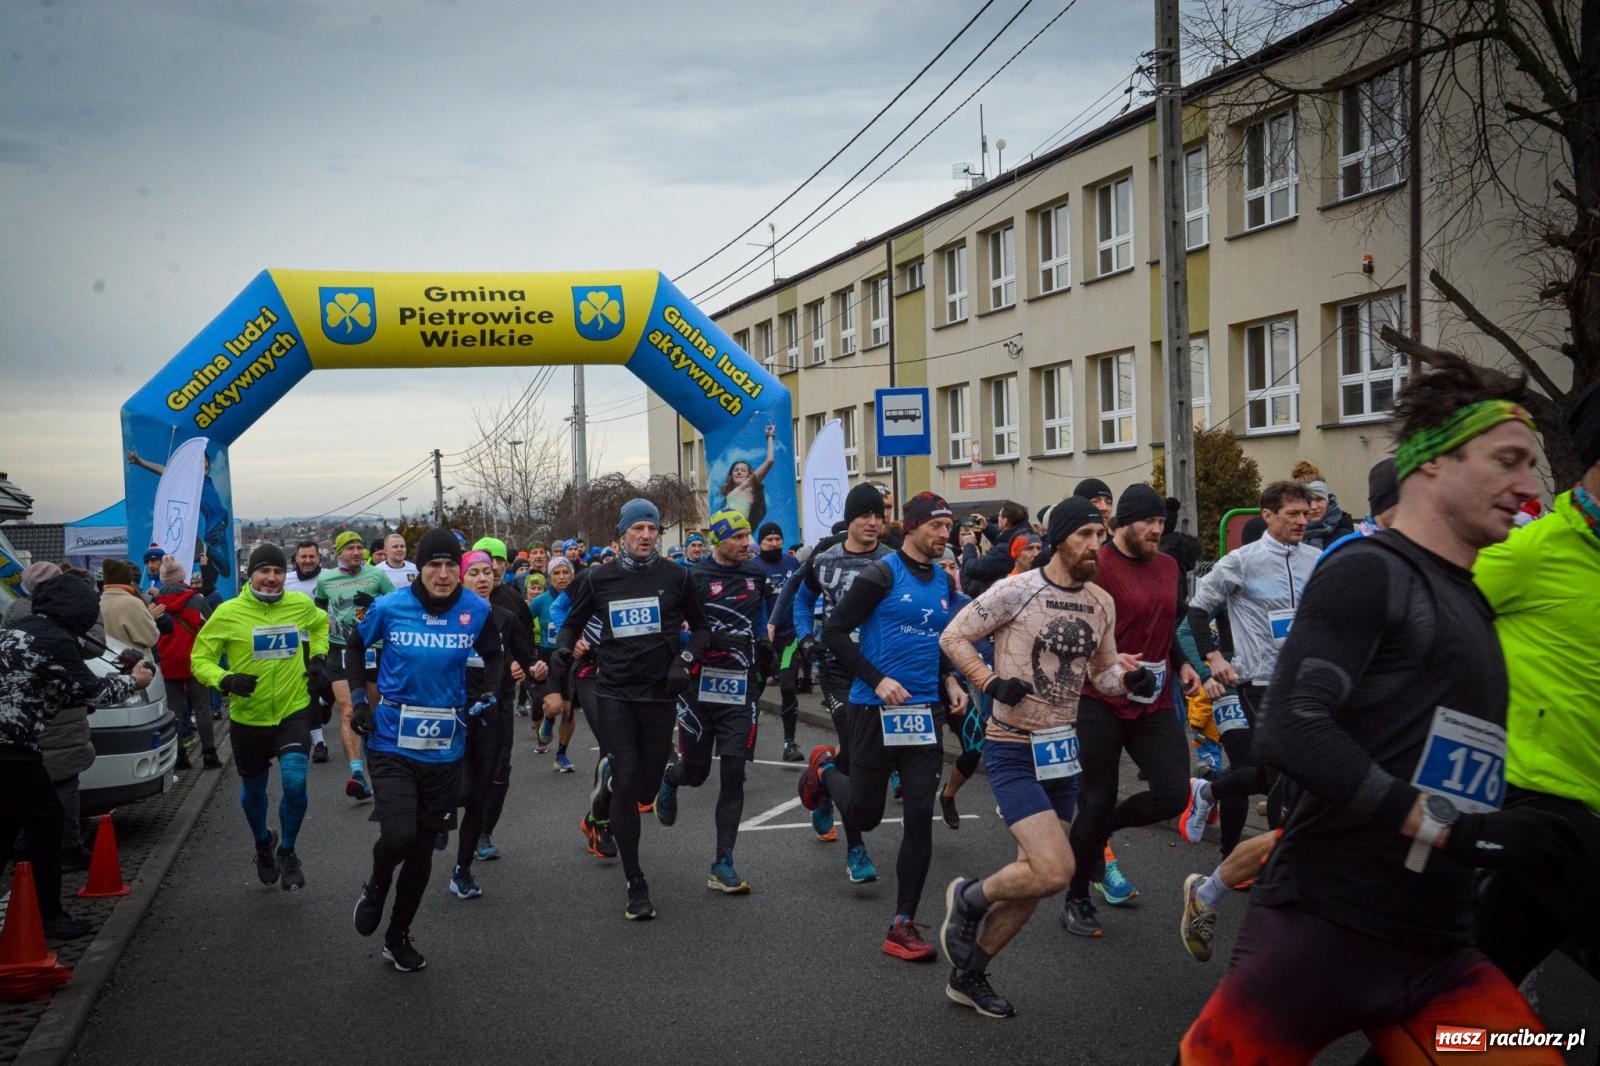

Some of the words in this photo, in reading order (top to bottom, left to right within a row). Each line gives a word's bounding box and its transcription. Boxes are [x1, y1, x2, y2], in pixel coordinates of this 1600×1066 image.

[424, 286, 526, 302] Gmina
[399, 306, 554, 325] Pietrowice
[419, 329, 534, 347] Wielkie
[167, 354, 232, 411] Gmina
[224, 306, 279, 357] ludzi
[663, 305, 717, 361] Gmina
[716, 353, 764, 400] ludzi
[194, 332, 298, 429] aktywnych
[648, 328, 743, 417] aktywnych
[619, 607, 652, 626] 188
[267, 634, 288, 649] 71
[389, 631, 475, 649] RUNNERS
[709, 679, 739, 694] 163
[416, 719, 441, 737] 66
[892, 715, 926, 732] 148
[1045, 738, 1076, 763] 116
[1442, 746, 1501, 801] 176
